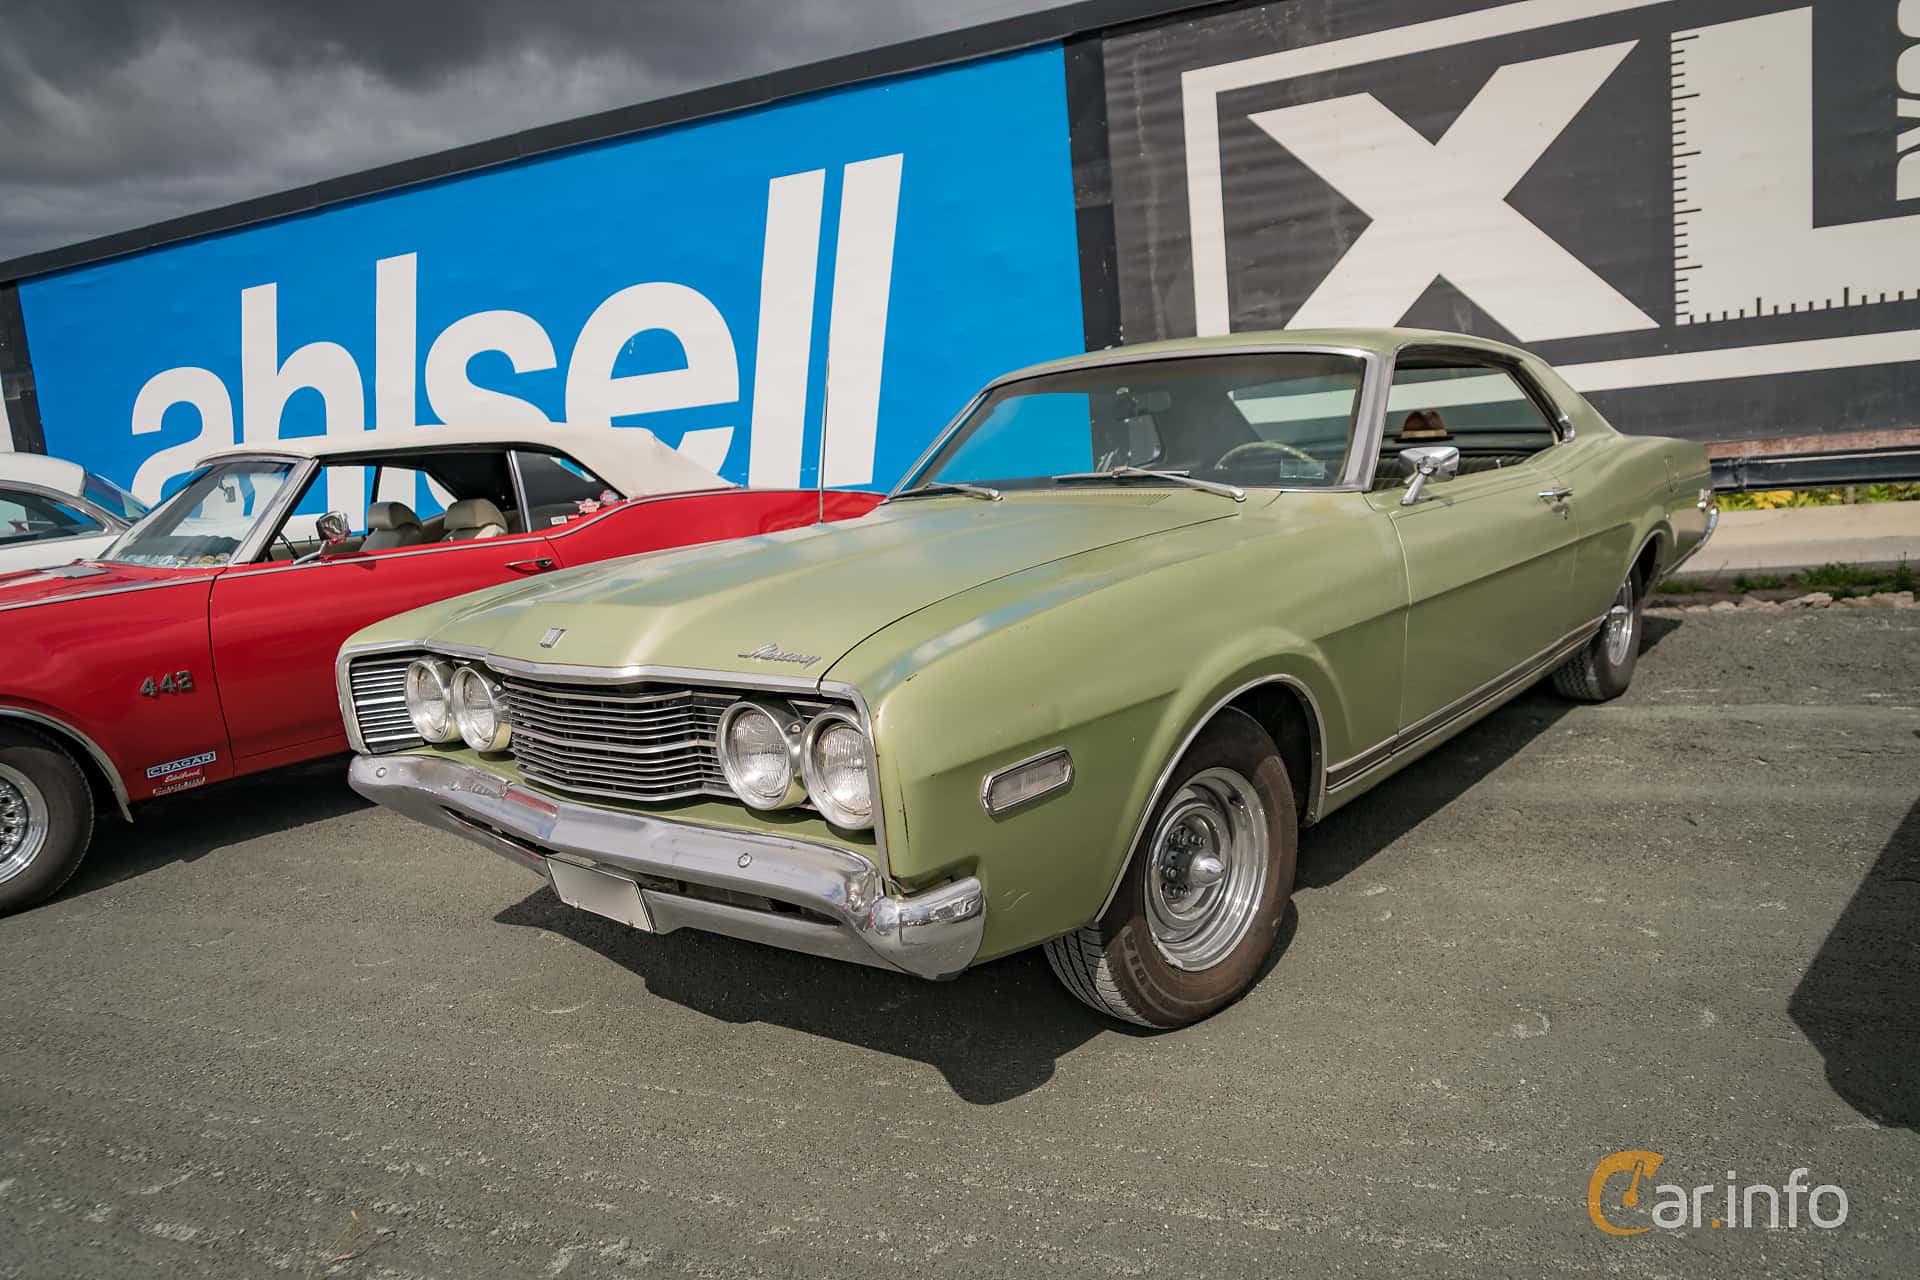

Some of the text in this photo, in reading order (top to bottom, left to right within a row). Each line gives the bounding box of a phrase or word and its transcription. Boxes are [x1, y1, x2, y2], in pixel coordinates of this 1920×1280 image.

[1247, 6, 1920, 342] XL
[131, 153, 904, 535] ahlsell
[140, 670, 193, 697] 442
